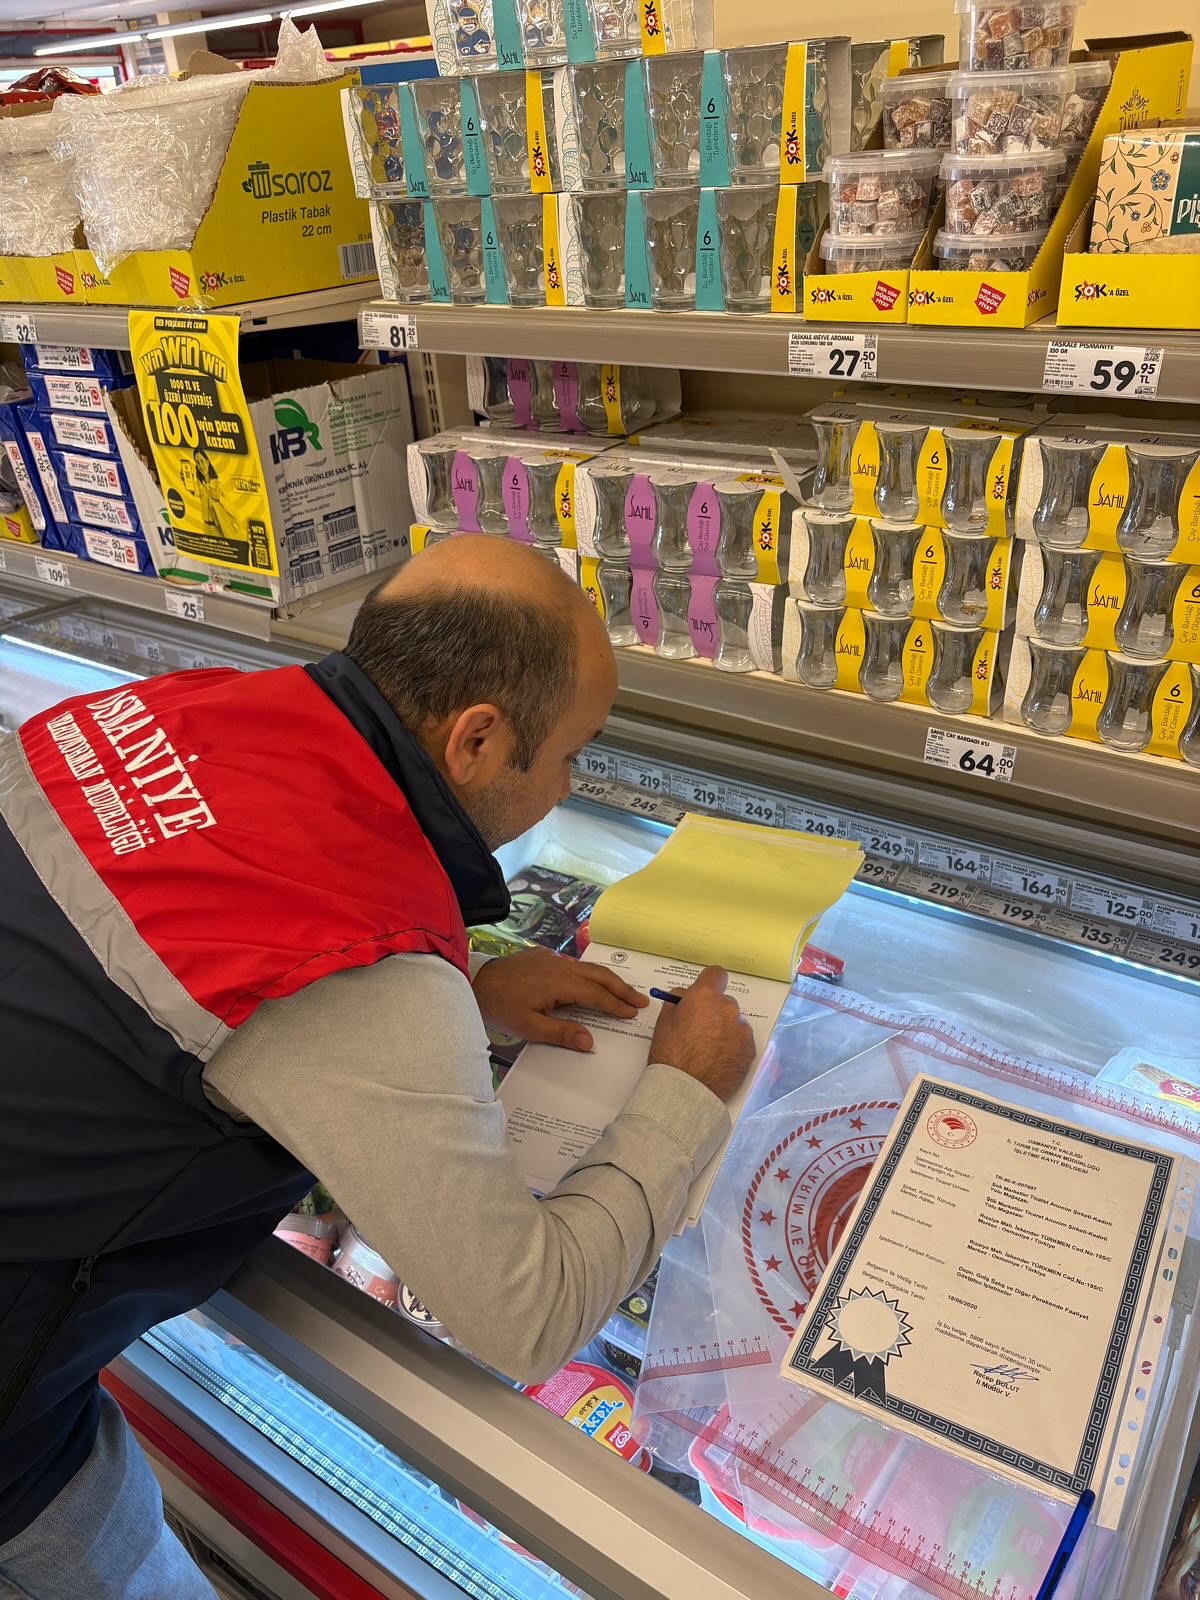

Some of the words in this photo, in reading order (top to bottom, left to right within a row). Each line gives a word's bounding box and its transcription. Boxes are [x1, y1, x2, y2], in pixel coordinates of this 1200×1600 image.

[707, 98, 715, 113] 6
[468, 117, 474, 131] 6
[272, 170, 332, 196] saroz
[262, 209, 297, 223] Plastik
[300, 204, 331, 219] Tabak
[302, 225, 314, 237] 22
[317, 225, 332, 235] cm
[703, 230, 712, 245] 6
[486, 232, 493, 245] 6
[811, 287, 836, 305] ŞOK
[887, 288, 898, 297] GÜN
[909, 288, 936, 305] ŞOK
[981, 286, 992, 294] HER
[991, 291, 1003, 300] GÜN
[1074, 280, 1108, 302] ŞOK
[1115, 289, 1129, 297] ÖZEL
[978, 294, 999, 307] DÜŞÜK
[562, 362, 568, 373] 6
[170, 379, 184, 390] 1000
[184, 380, 192, 390] TL
[193, 381, 200, 391] VE
[1140, 375, 1150, 383] TL
[164, 389, 181, 403] ÜZERİ
[150, 402, 199, 448] 100
[197, 416, 214, 432] win
[215, 419, 239, 435] para
[204, 431, 235, 450] kazan
[931, 451, 939, 465] 6
[512, 474, 518, 486] 6
[700, 502, 708, 513] 6
[926, 545, 934, 558] 6
[914, 635, 923, 648] 6
[1170, 684, 1180, 697] 6
[957, 735, 980, 744] BARDAGI
[86, 688, 218, 840] OSMANİYE
[80, 778, 157, 856] MÜDÜRLÜĞÜ
[1041, 1234, 1071, 1248] TÜRKMEN
[1031, 1261, 1062, 1276] TÜRKMEN
[973, 1369, 995, 1382] Recep
[982, 1382, 1003, 1395] Müdür
